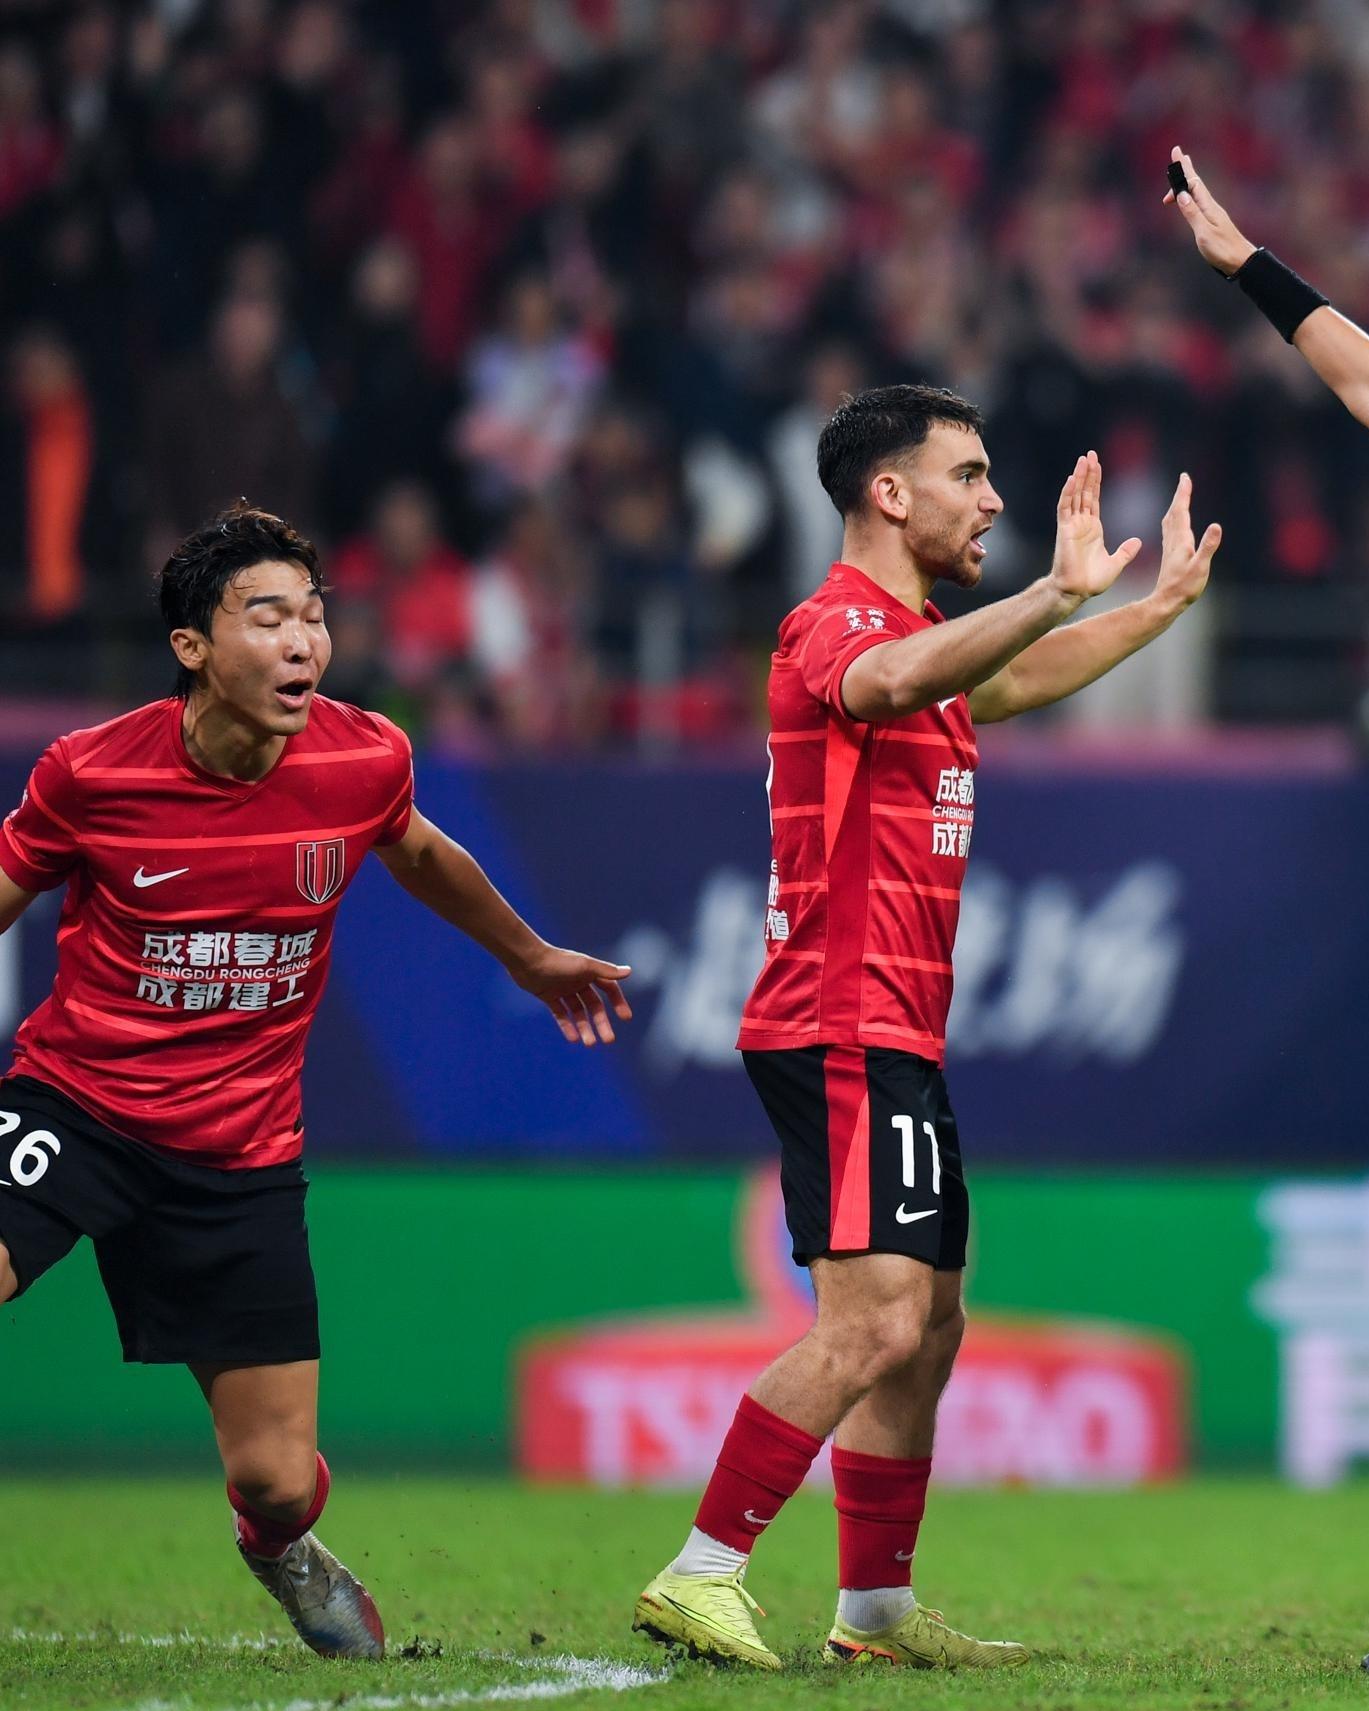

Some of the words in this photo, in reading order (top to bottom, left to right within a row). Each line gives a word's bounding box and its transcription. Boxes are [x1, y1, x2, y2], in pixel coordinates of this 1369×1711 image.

[142, 928, 317, 966] 成都蓉城
[139, 961, 215, 980] CHENGDU
[220, 958, 312, 980] RONGCHENG
[136, 971, 307, 1011] 成都建工
[891, 1114, 941, 1195] 11
